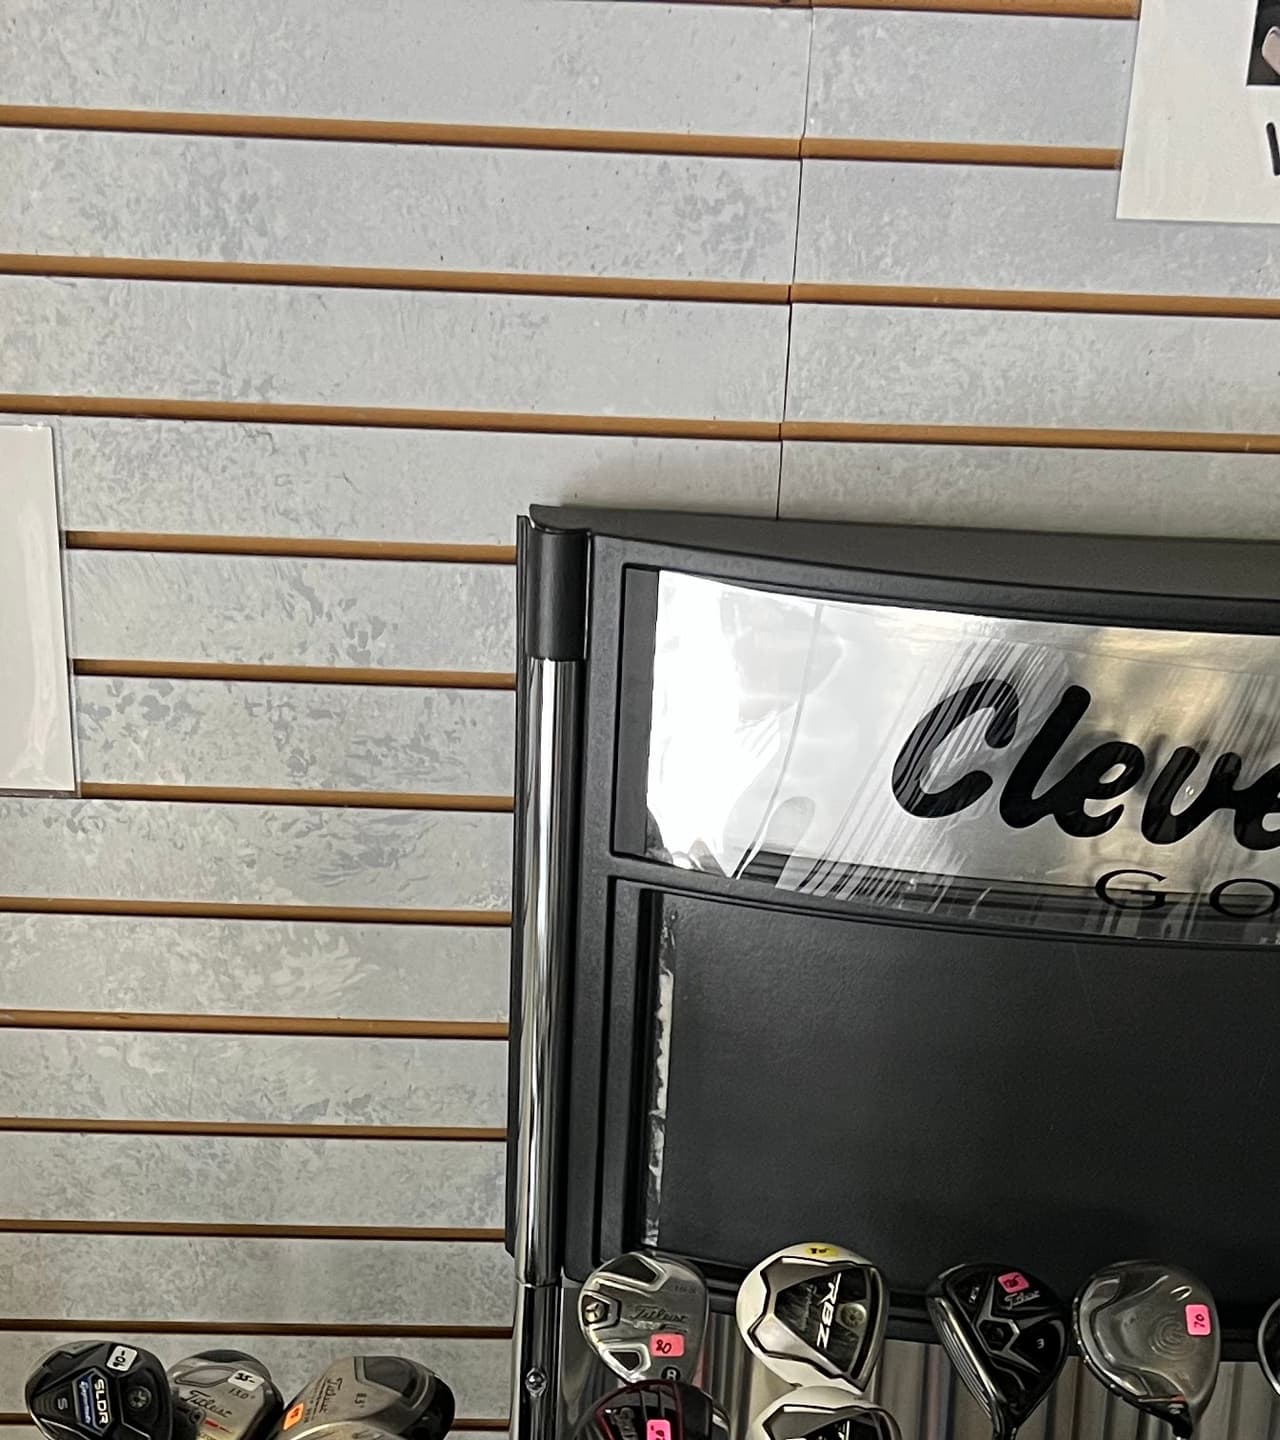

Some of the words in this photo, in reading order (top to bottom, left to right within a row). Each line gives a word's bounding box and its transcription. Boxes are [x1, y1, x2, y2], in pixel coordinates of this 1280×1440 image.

[816, 1272, 842, 1350] RBZ
[1193, 1313, 1206, 1329] 70
[655, 1339, 673, 1355] 80
[1037, 1338, 1045, 1349] 3
[93, 1376, 110, 1426] SLDR
